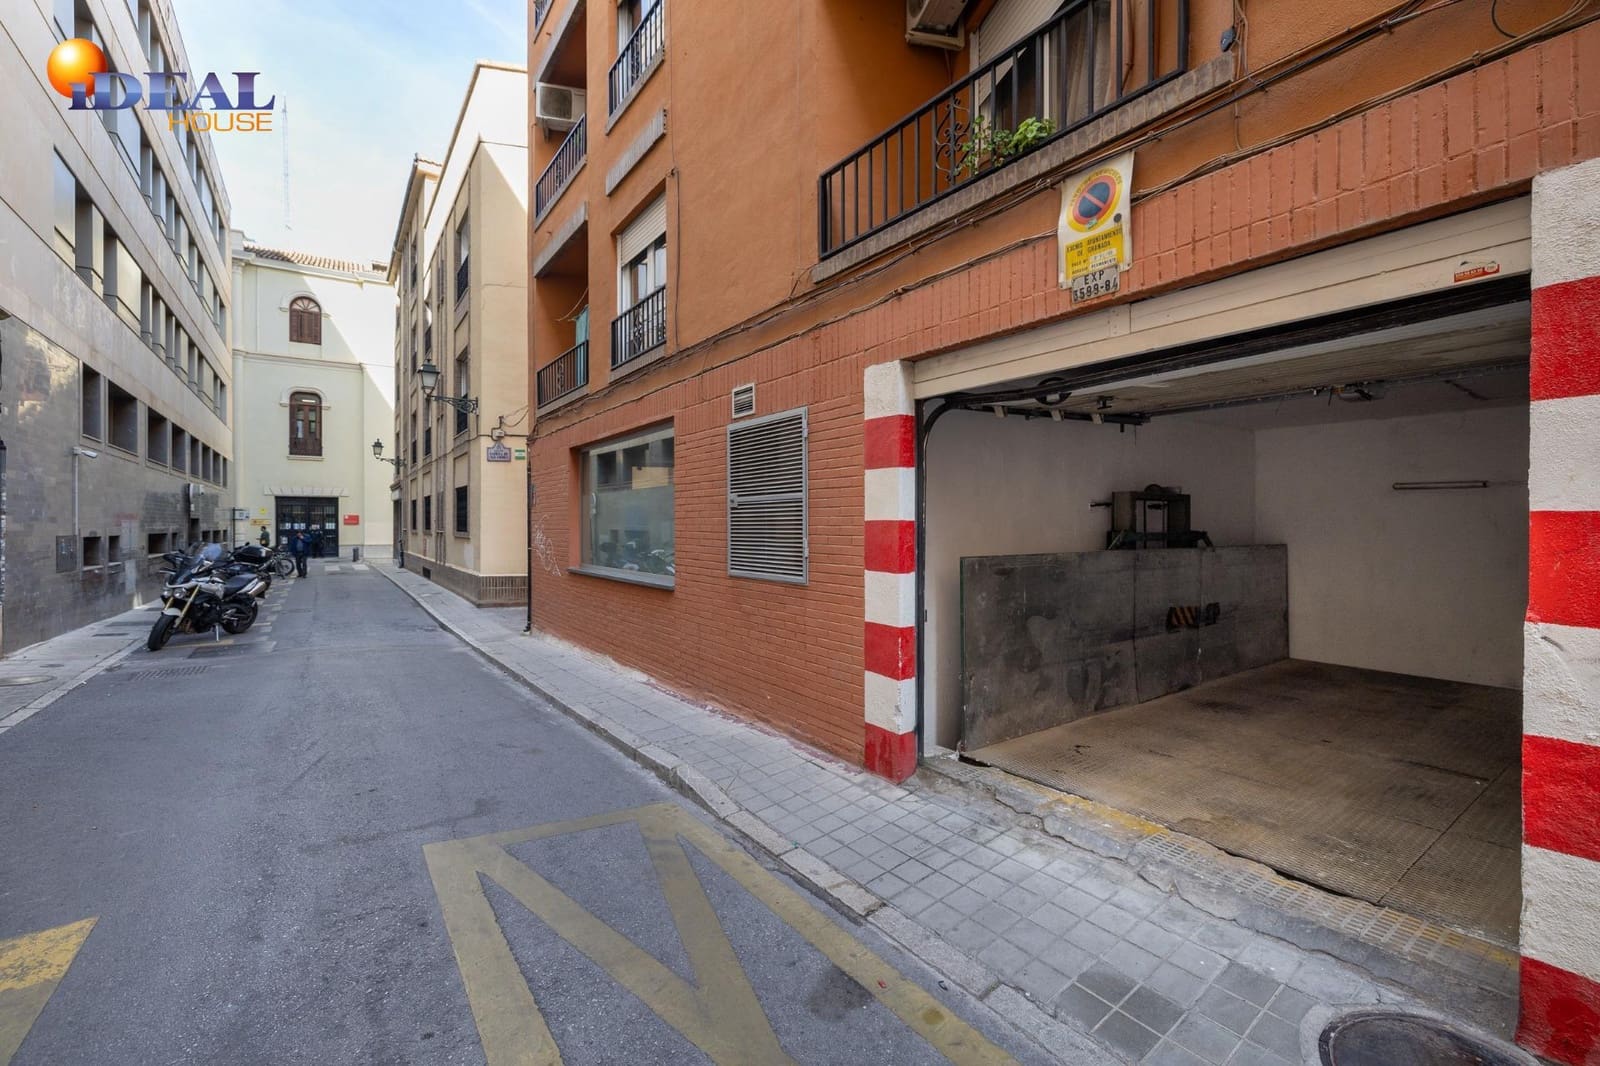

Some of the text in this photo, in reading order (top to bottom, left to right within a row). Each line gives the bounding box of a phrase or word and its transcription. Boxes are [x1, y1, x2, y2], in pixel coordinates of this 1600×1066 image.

[1087, 228, 1123, 246] AYUNTAMIENTO
[1087, 240, 1111, 253] GRANADA
[1084, 269, 1105, 286] EXP
